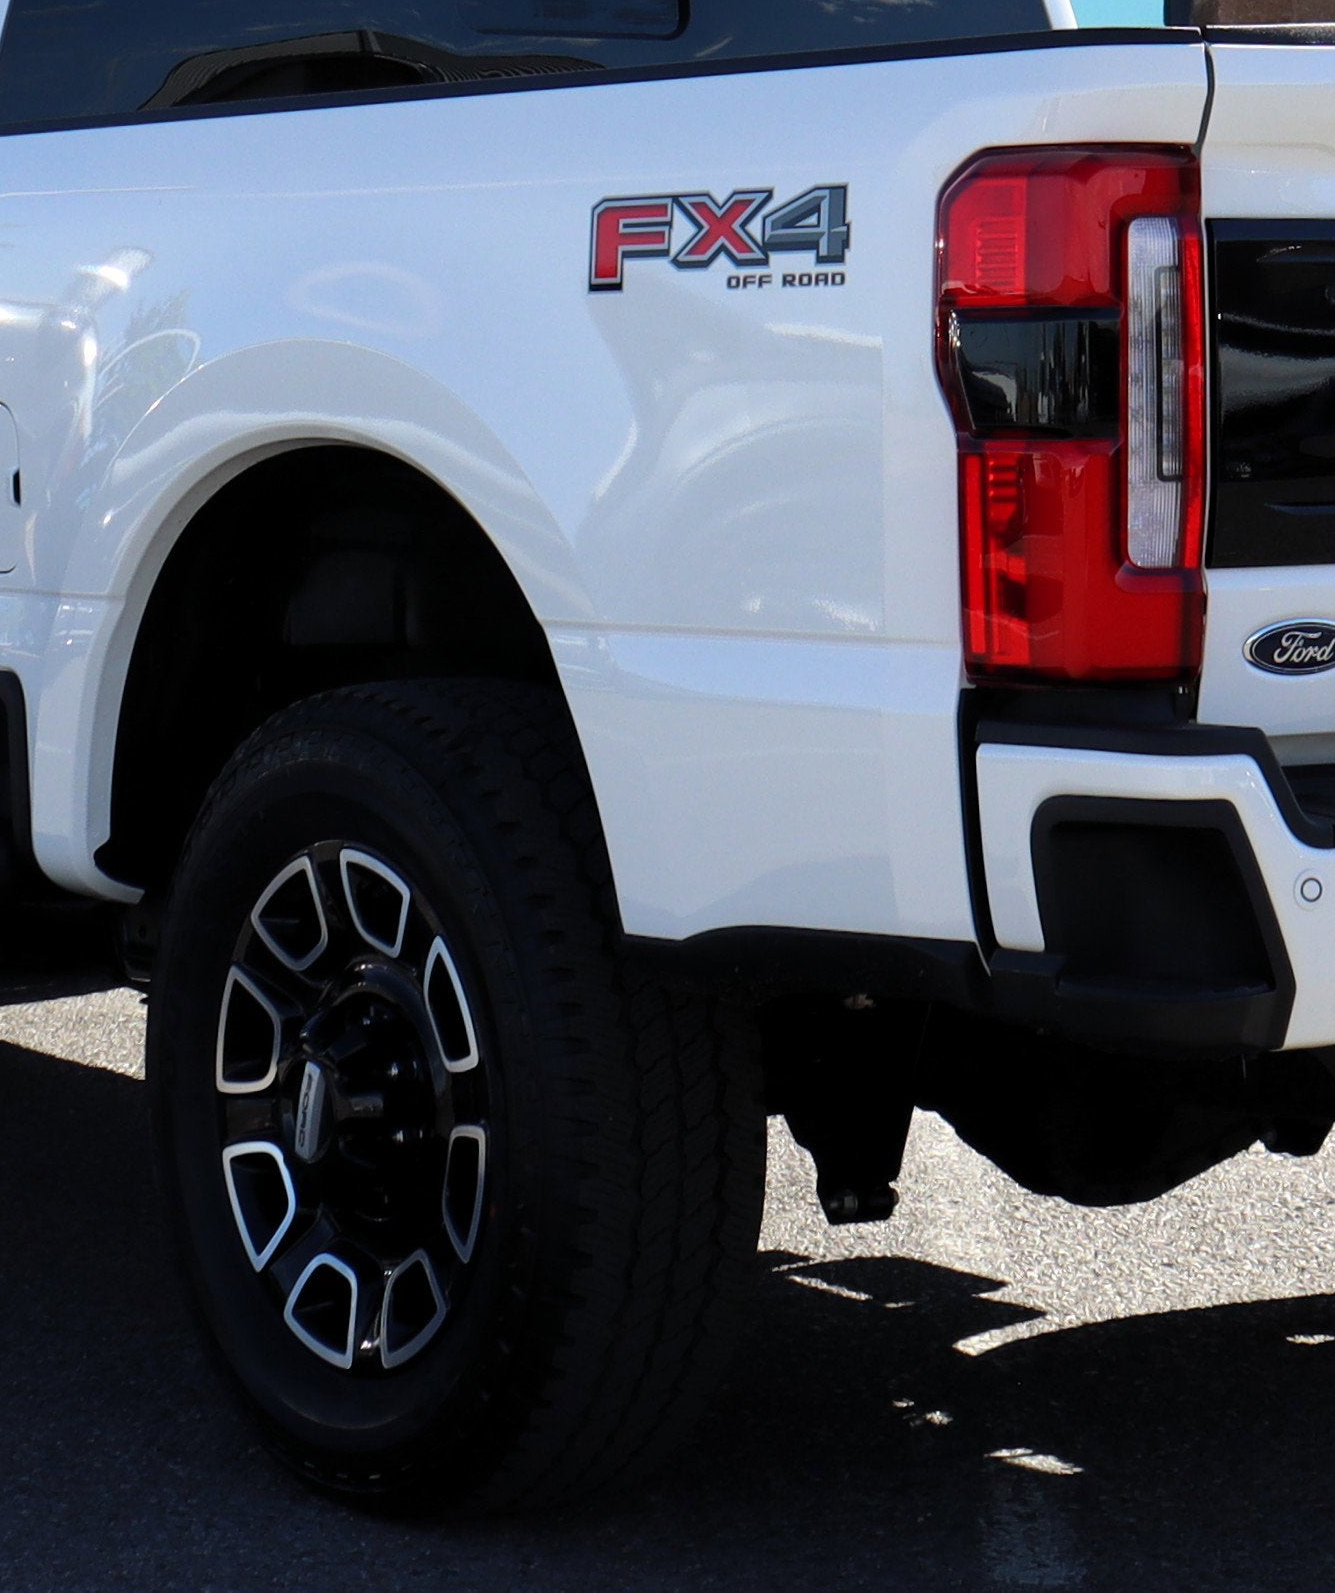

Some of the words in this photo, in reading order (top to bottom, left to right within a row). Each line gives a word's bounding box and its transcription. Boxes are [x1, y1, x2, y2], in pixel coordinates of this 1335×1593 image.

[588, 182, 851, 293] FX4
[726, 274, 773, 289] OFF
[781, 272, 846, 287] ROAD
[1273, 631, 1335, 663] Ford
[295, 1068, 313, 1147] FORD
